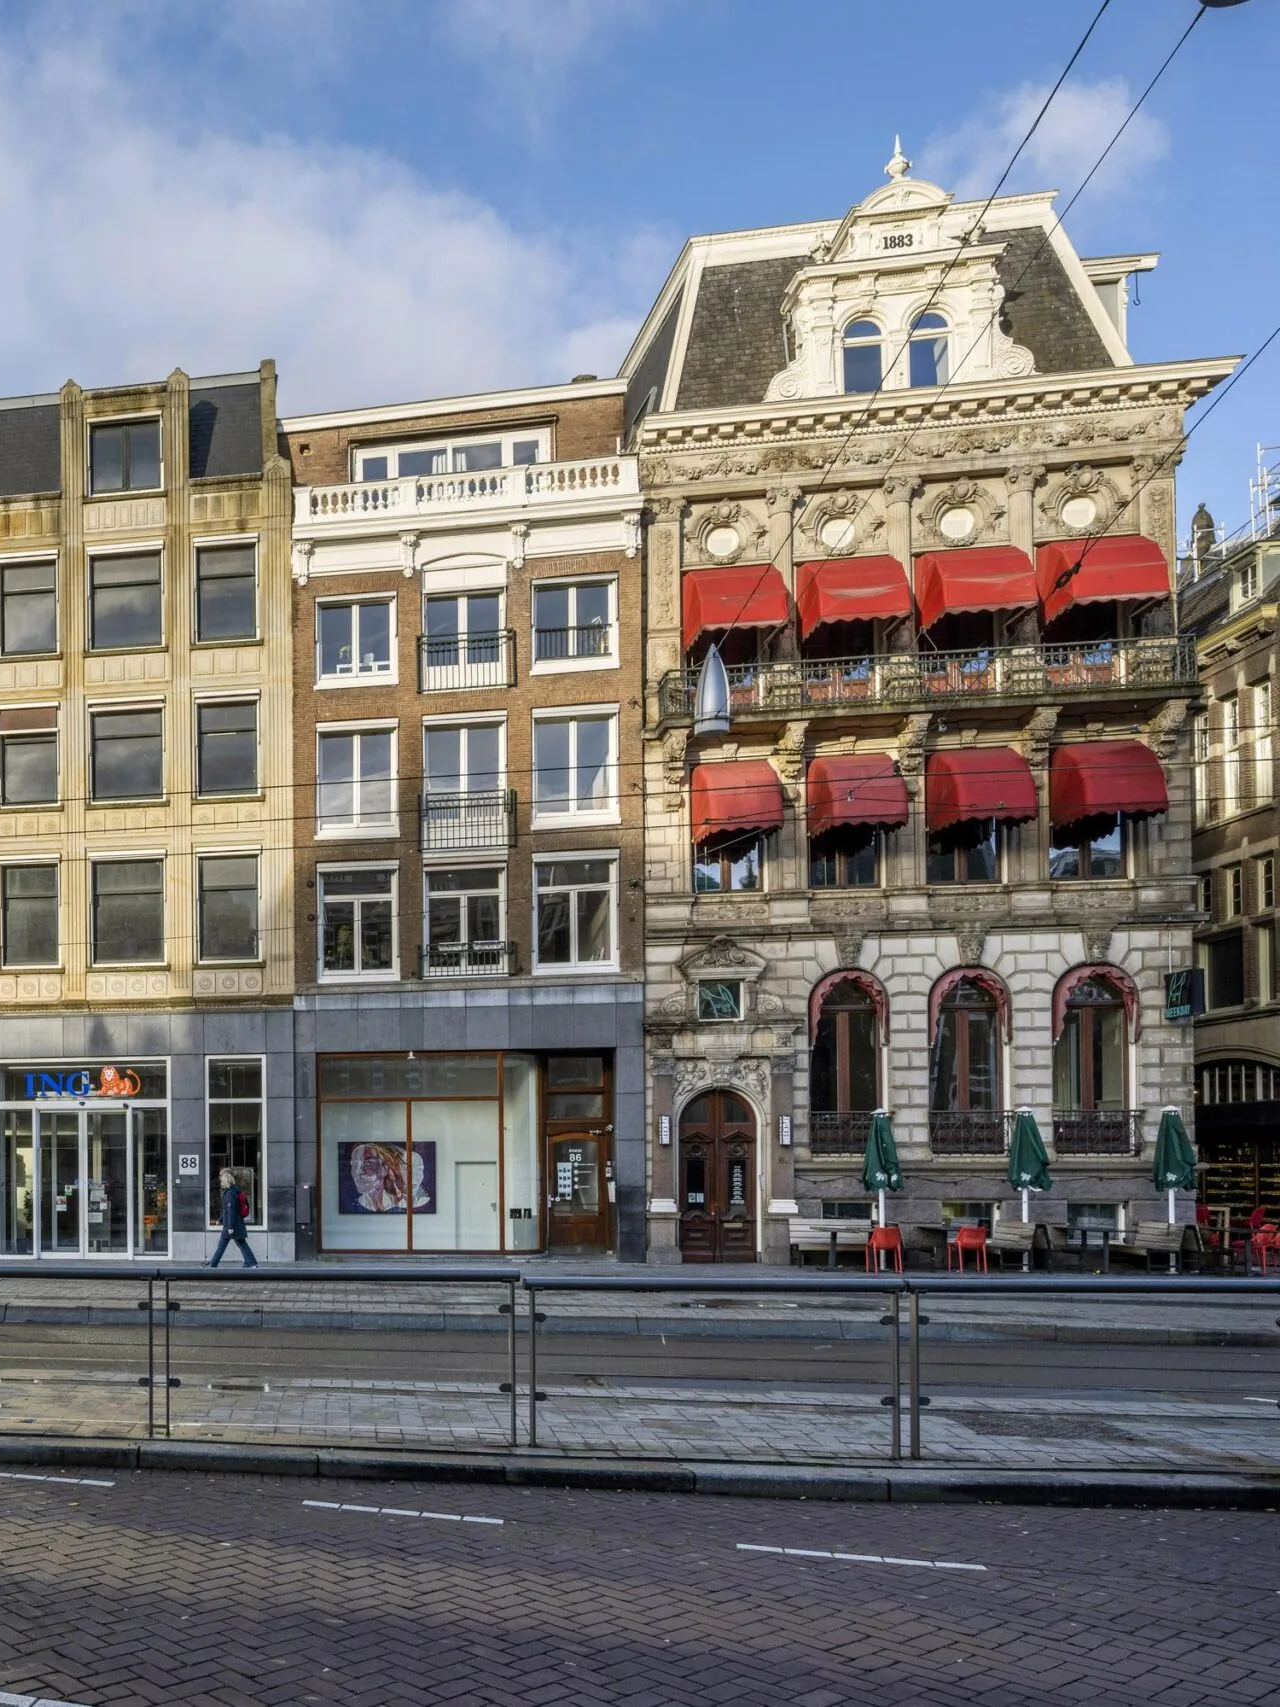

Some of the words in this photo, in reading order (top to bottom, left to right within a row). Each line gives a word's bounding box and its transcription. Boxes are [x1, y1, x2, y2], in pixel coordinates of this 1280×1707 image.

[882, 233, 913, 249] 1883
[24, 1070, 90, 1097] ING
[181, 1157, 197, 1168] 88
[569, 1153, 583, 1162] 86
